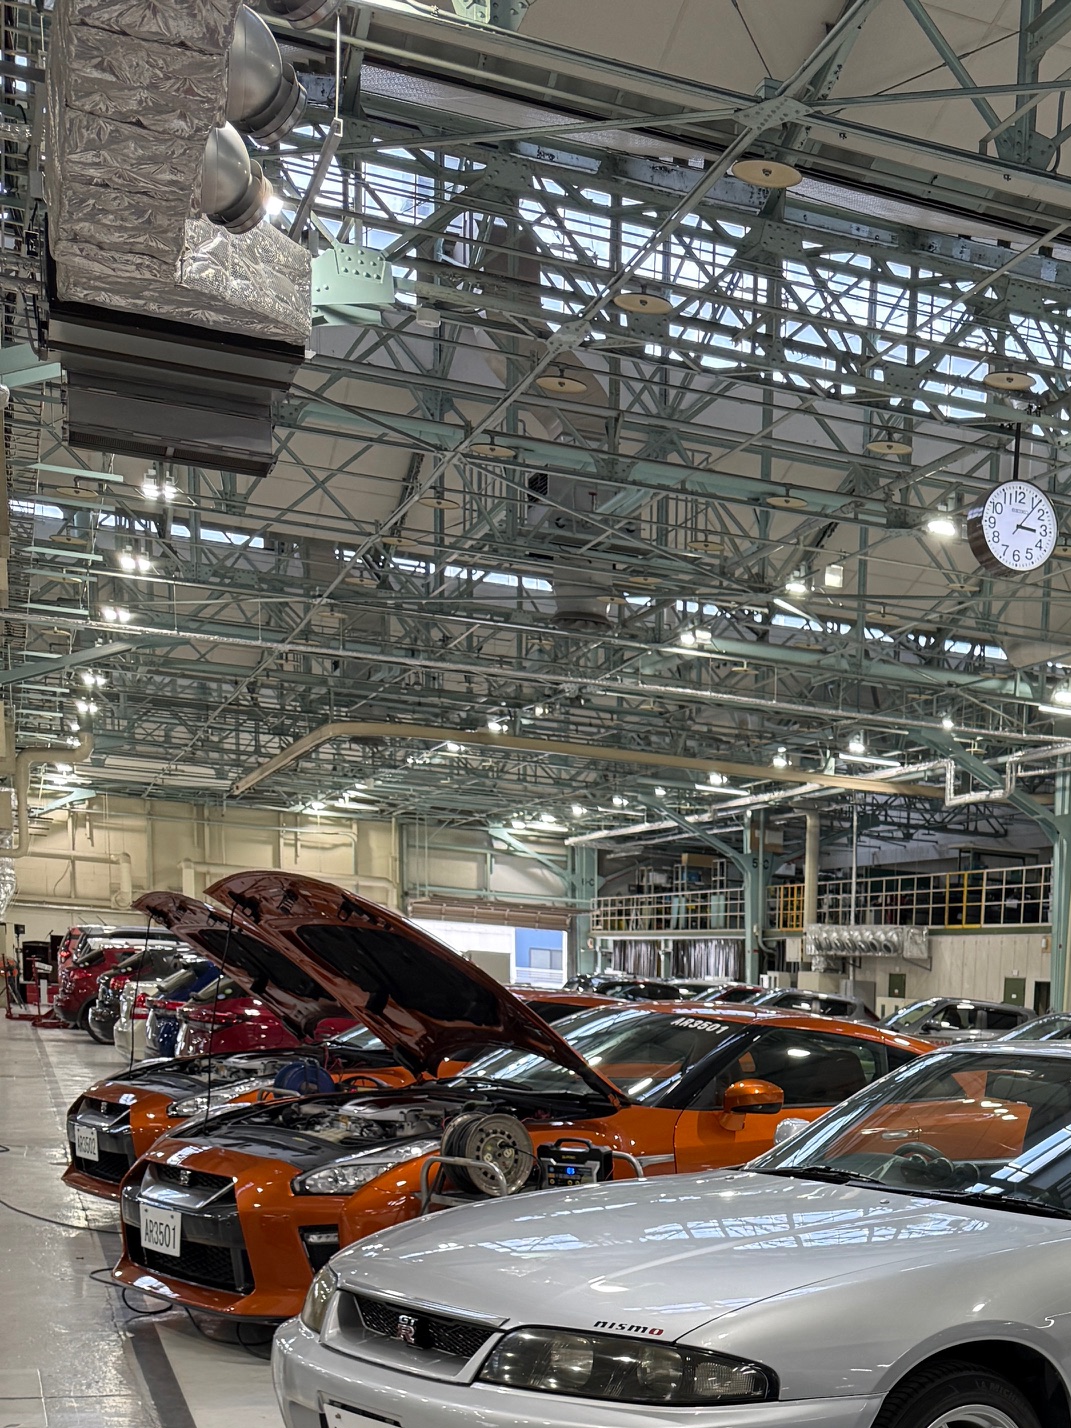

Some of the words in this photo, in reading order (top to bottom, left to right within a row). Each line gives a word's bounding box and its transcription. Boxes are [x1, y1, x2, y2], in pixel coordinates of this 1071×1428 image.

[1014, 490, 1026, 504] 12
[991, 501, 1004, 515] 10
[1037, 509, 1045, 521] 2
[988, 516, 997, 529] 9
[992, 531, 1000, 543] 8
[1039, 524, 1048, 537] 3
[1001, 544, 1009, 556] 7
[1035, 539, 1043, 551] 4
[1012, 550, 1020, 562] 6
[1025, 548, 1033, 560] 5
[670, 1017, 730, 1035] AR3501
[144, 1219, 177, 1250] AR3501
[398, 1314, 419, 1326] GT
[396, 1323, 415, 1344] R
[593, 1320, 665, 1336] nismo
